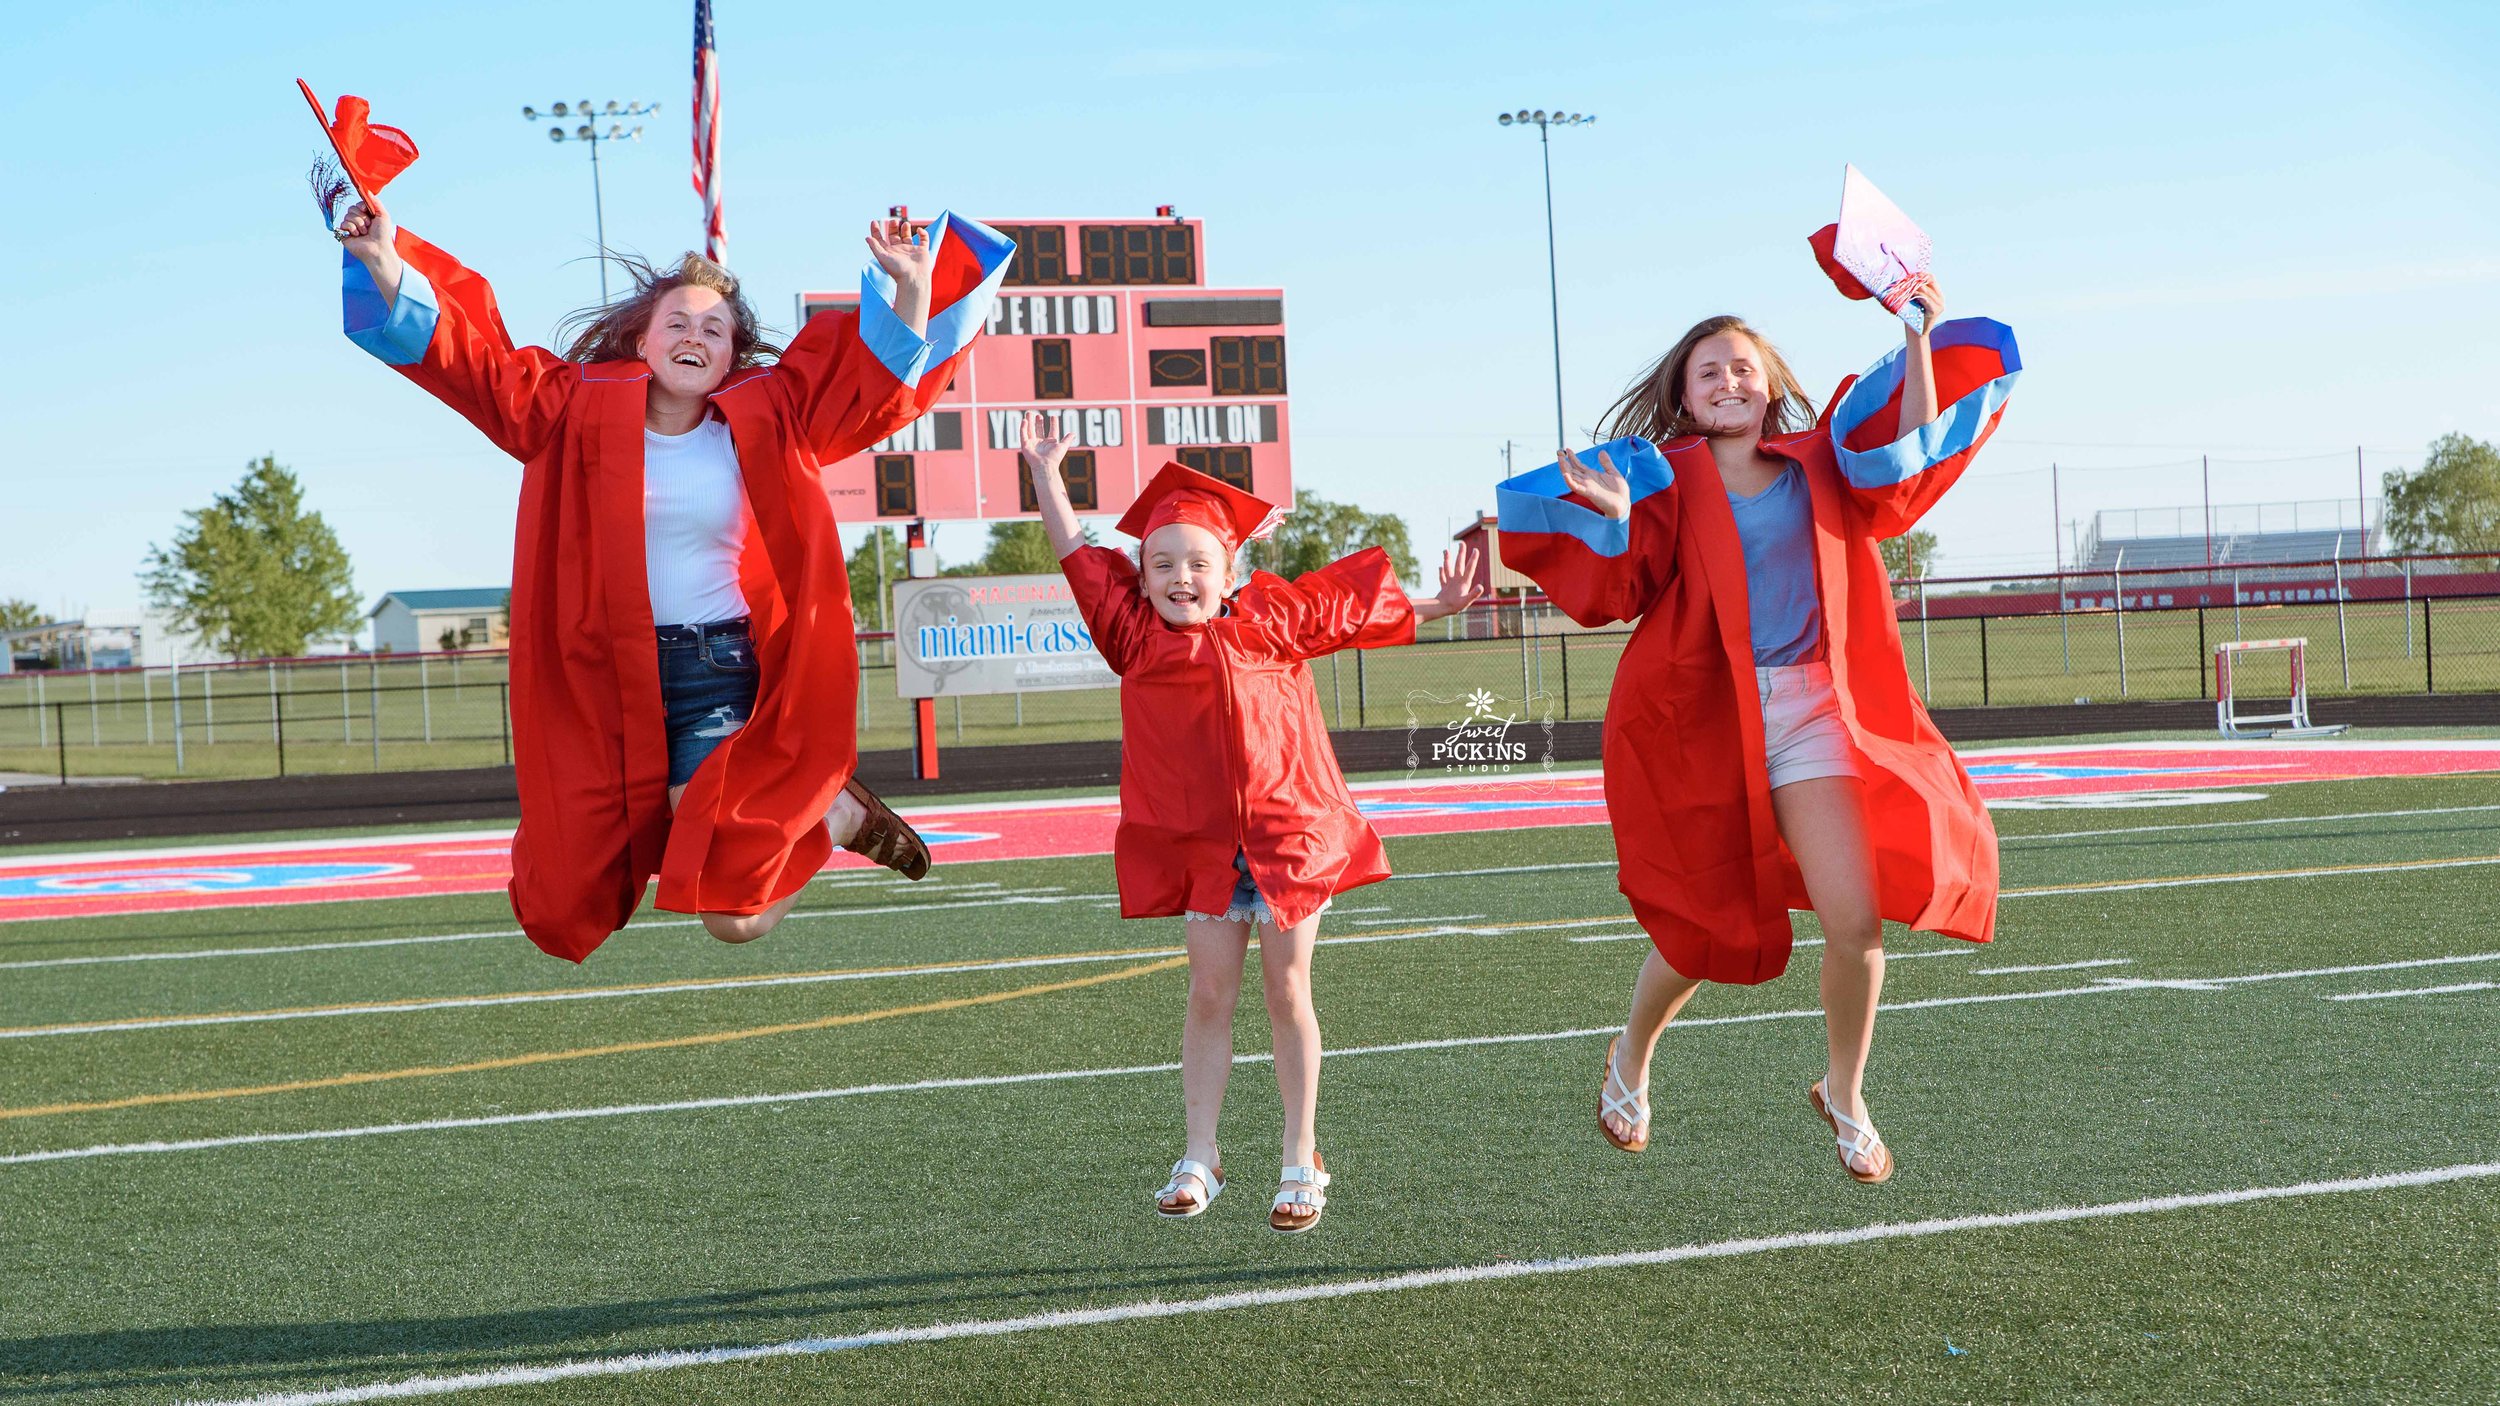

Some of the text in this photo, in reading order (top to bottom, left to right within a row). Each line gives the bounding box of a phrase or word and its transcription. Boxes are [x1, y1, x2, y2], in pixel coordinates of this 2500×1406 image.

[986, 295, 1115, 335] PERIOD
[859, 411, 936, 453] WN
[1085, 408, 1122, 447] GO
[1163, 404, 1262, 445] BALL ON
